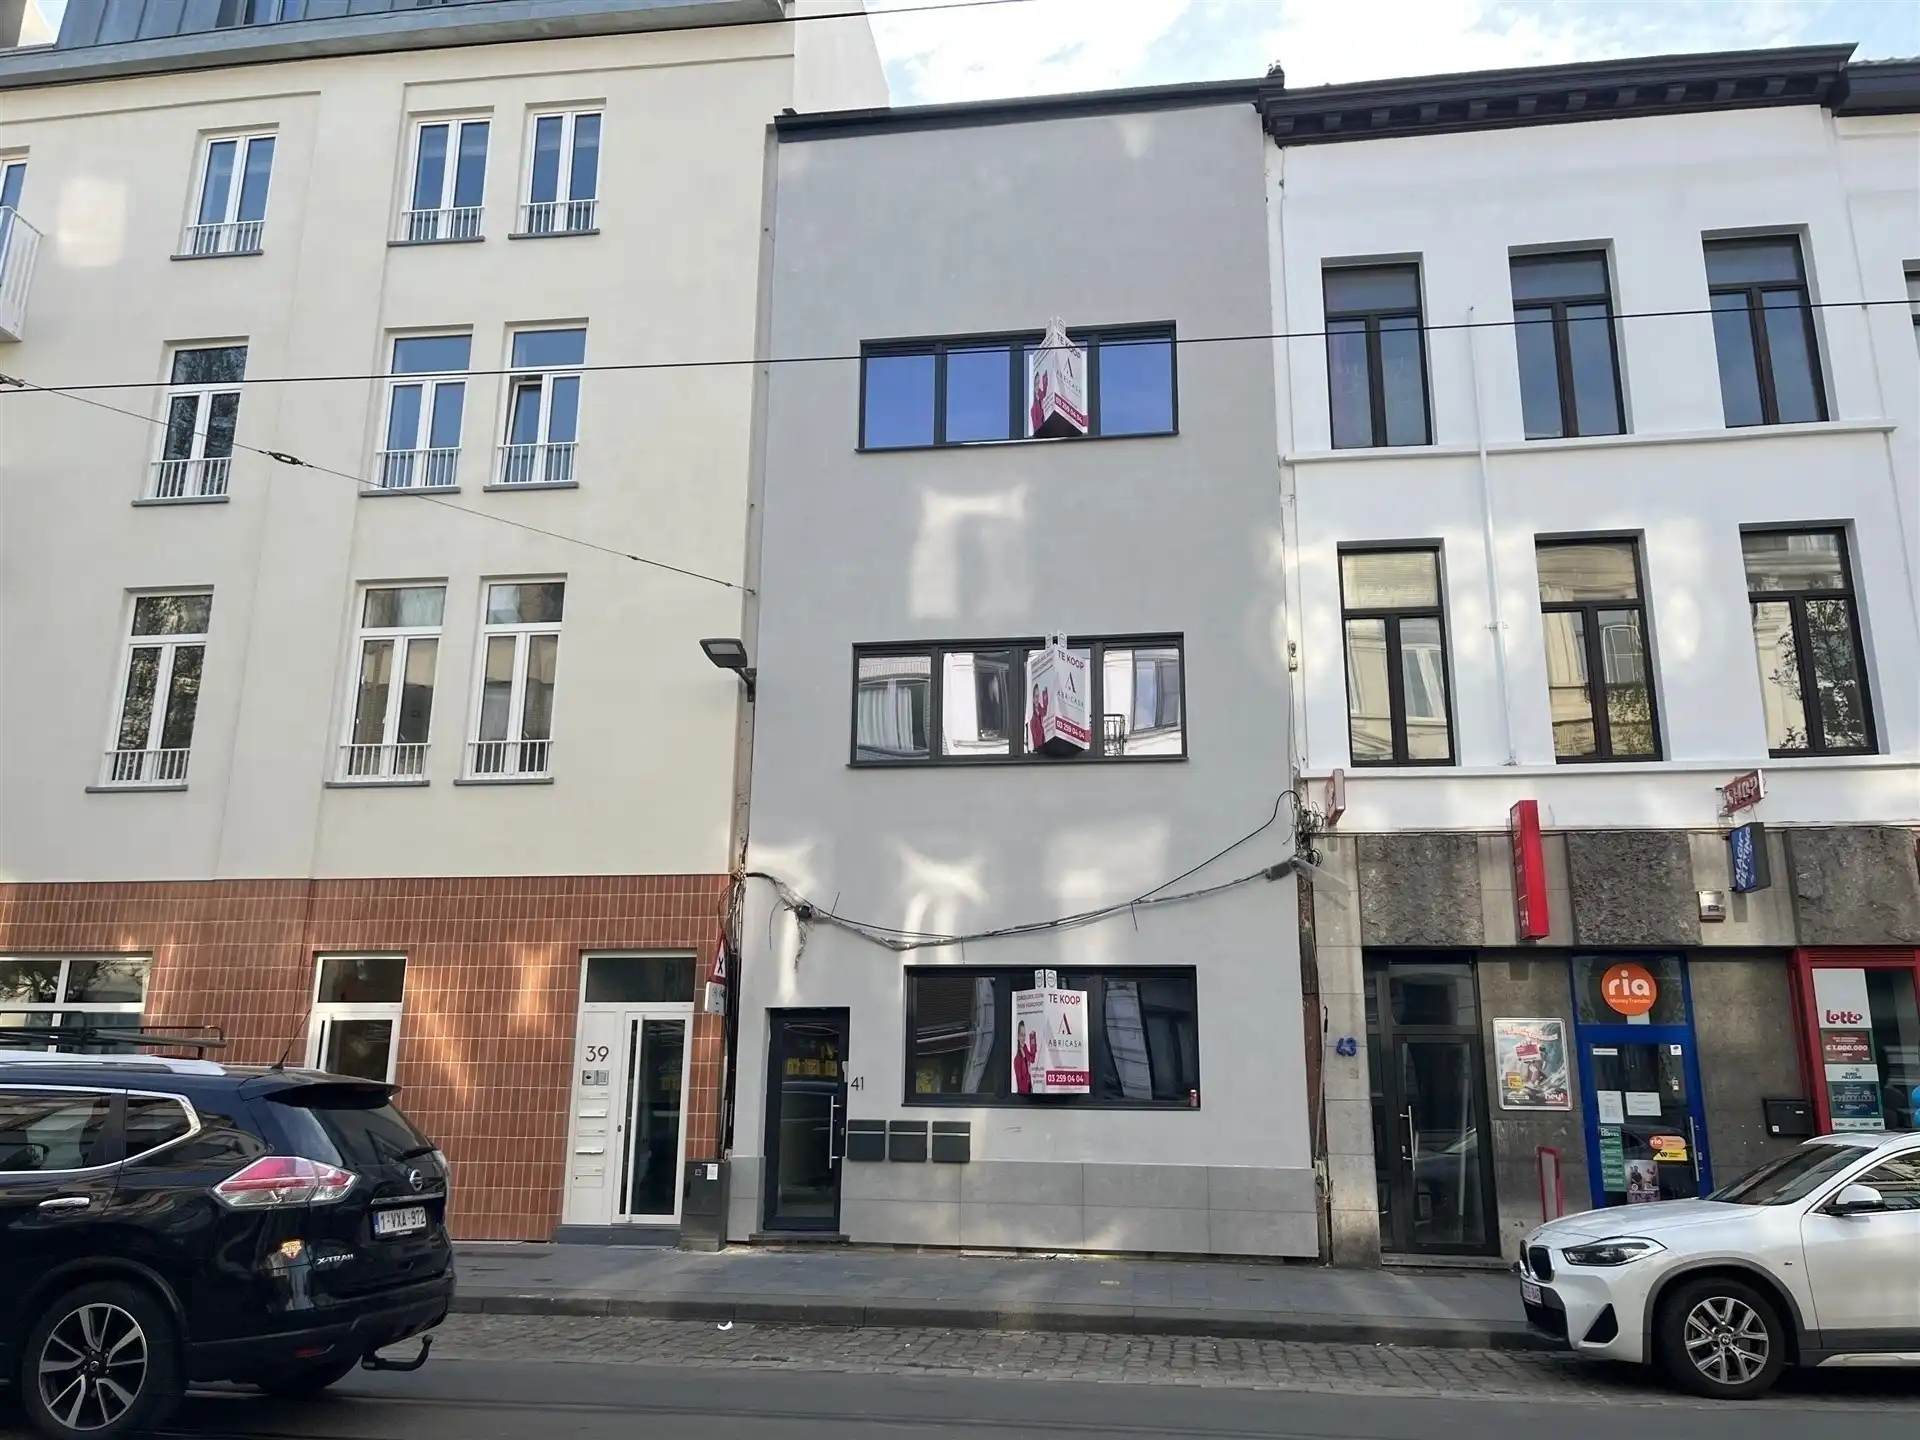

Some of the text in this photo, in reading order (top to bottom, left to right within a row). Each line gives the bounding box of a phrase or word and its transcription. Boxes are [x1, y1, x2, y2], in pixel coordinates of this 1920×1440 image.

[1056, 332, 1065, 345] TE
[1057, 649, 1065, 662] TE
[1066, 653, 1085, 670] KOOP
[1056, 688, 1085, 708] ABRICASA
[1062, 722, 1072, 733] 259
[1726, 775, 1758, 806] SHOP
[1608, 970, 1650, 996] ria
[1048, 993, 1081, 1005] TE KOOP
[1048, 1039, 1082, 1048] ABRICASA
[1336, 1037, 1357, 1057] 43
[585, 1045, 609, 1062] 39
[850, 1076, 865, 1091] 41
[1047, 1074, 1055, 1082] 03
[1056, 1074, 1066, 1083] 259
[1067, 1074, 1075, 1083] 04
[1076, 1074, 1084, 1083] 04
[1544, 1092, 1564, 1101] hey!
[380, 1208, 426, 1230] 1-VXA-972
